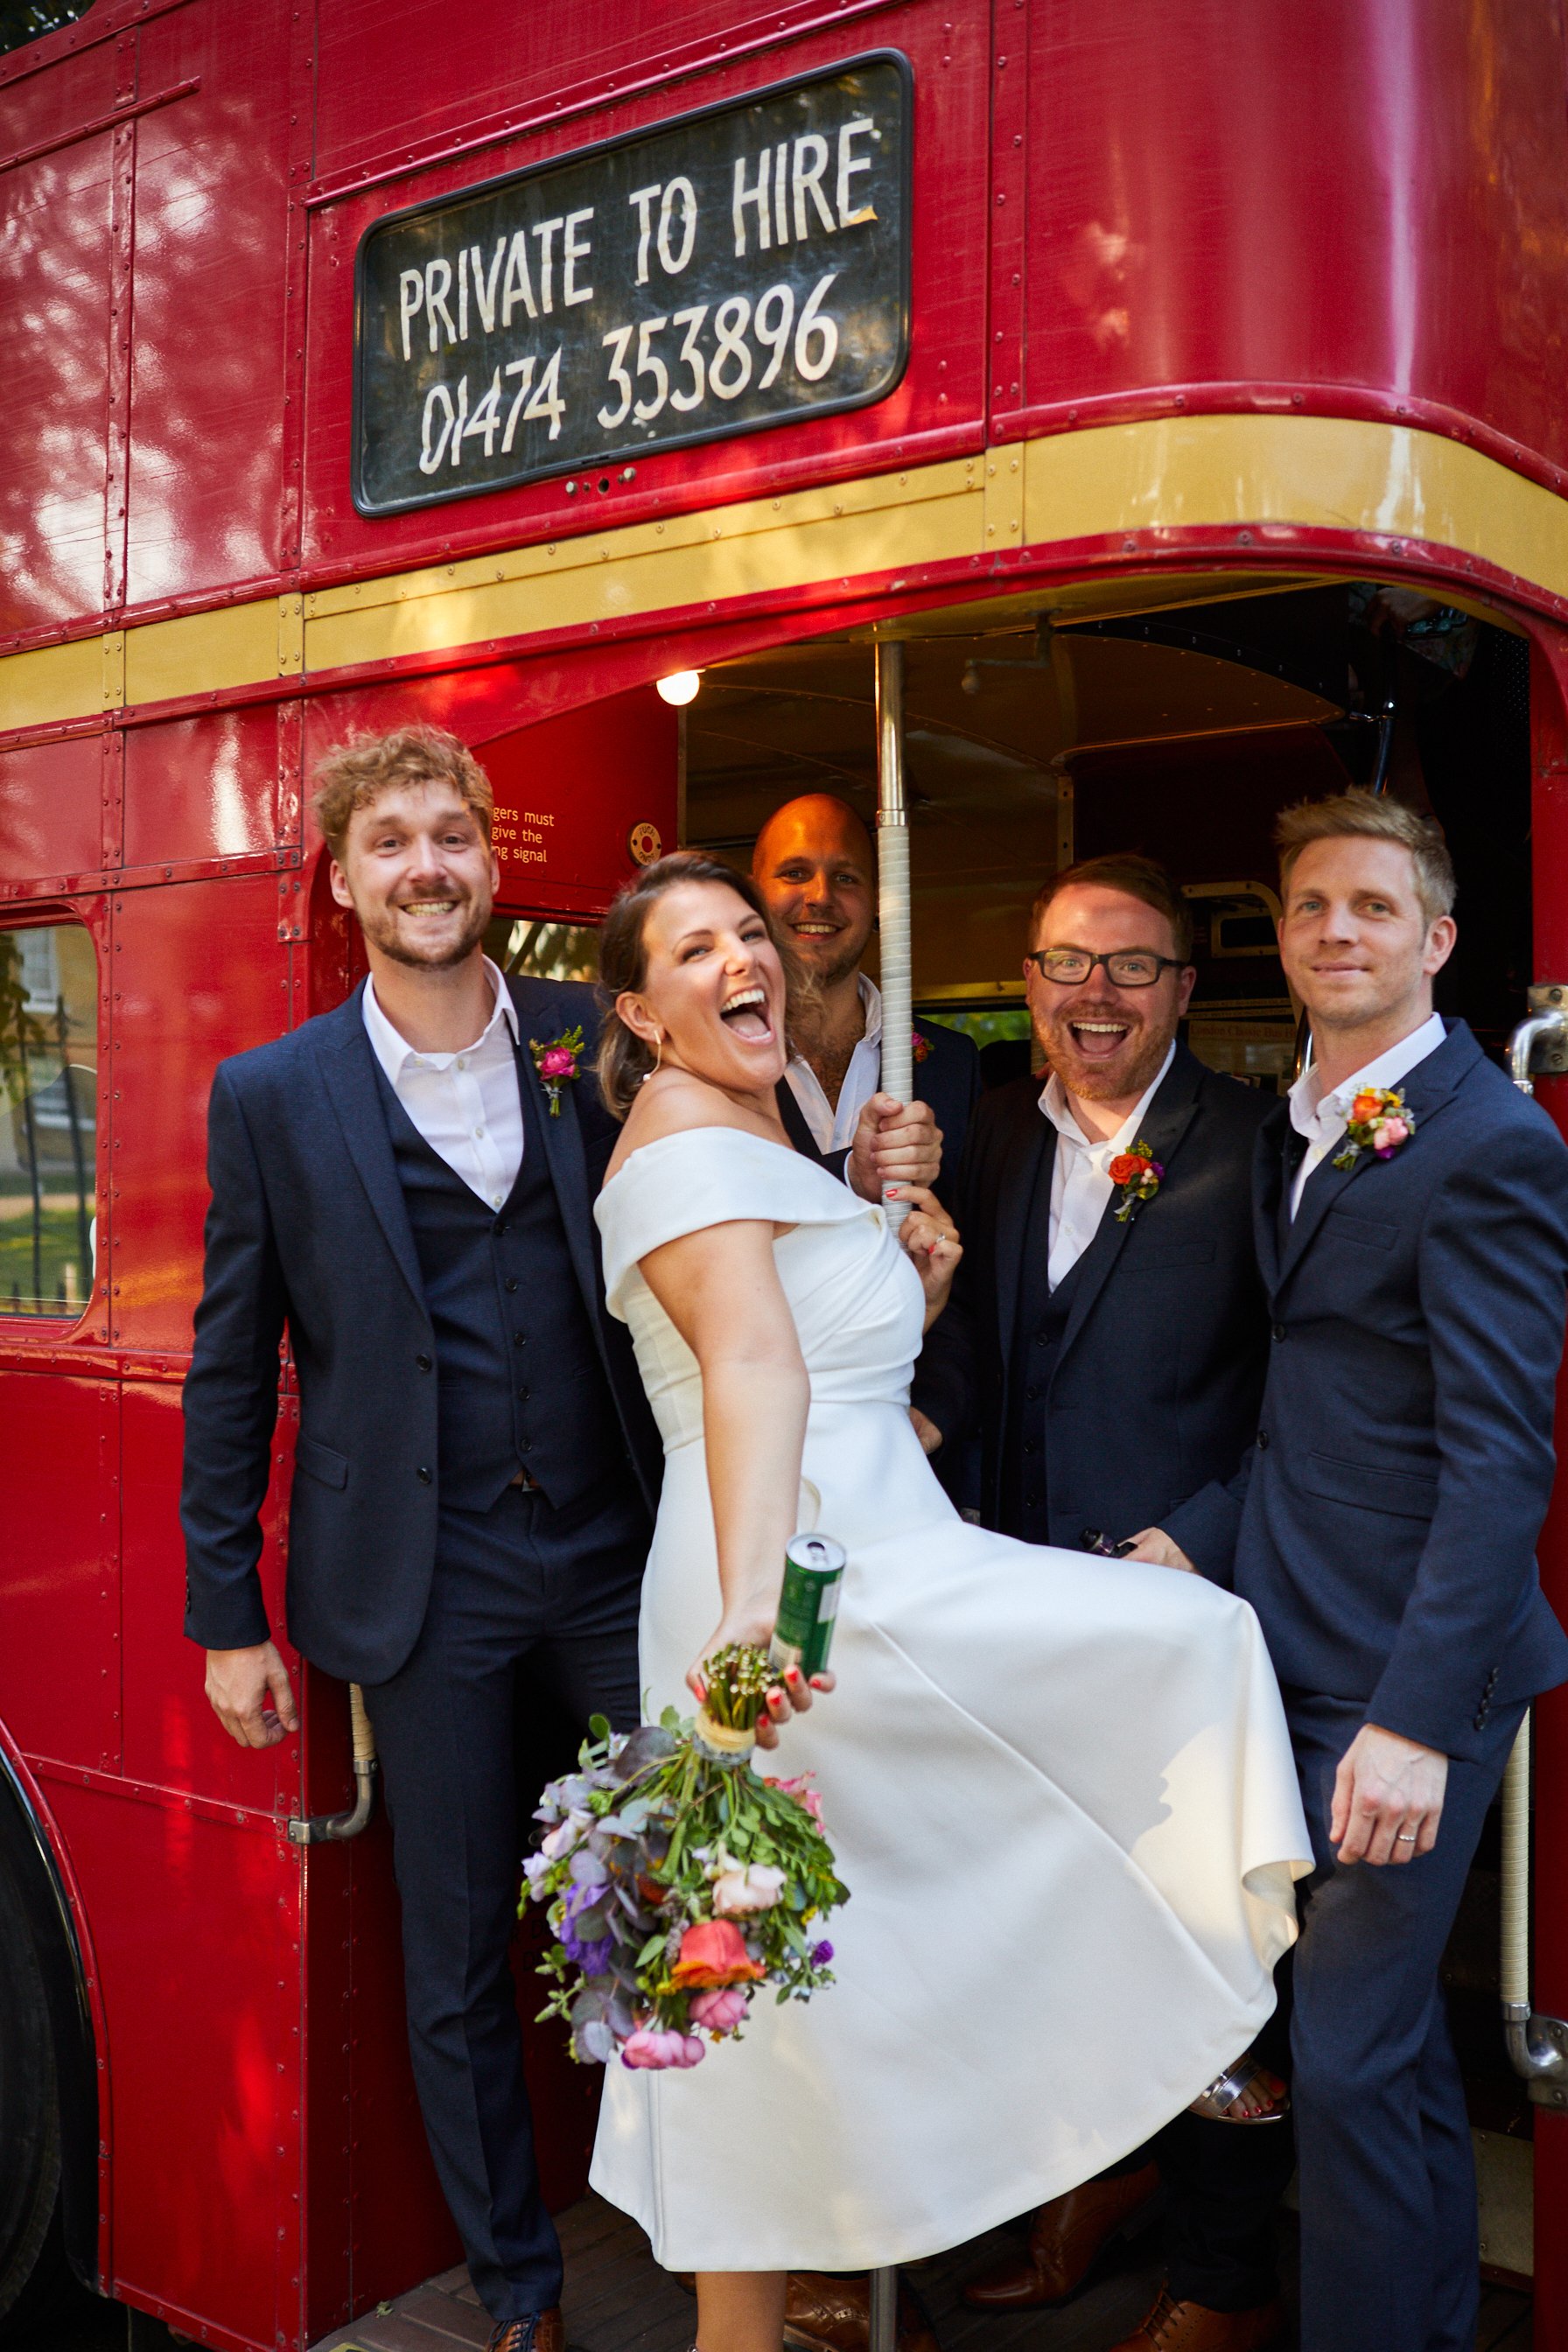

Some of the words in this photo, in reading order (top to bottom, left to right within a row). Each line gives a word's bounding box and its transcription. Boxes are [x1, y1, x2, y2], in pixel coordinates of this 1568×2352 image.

[400, 207, 594, 360] PRIVATE
[629, 177, 697, 287] TO
[732, 118, 878, 257] HIRE
[419, 346, 566, 475] 01474
[598, 273, 839, 430] 353896
[524, 812, 555, 827] must
[491, 824, 516, 841] give
[522, 829, 542, 844] the
[490, 842, 508, 861] ng
[513, 846, 547, 864] signal
[1190, 1024, 1226, 1036] London
[1227, 1025, 1263, 1038] Classic
[1264, 1026, 1284, 1038] Bus
